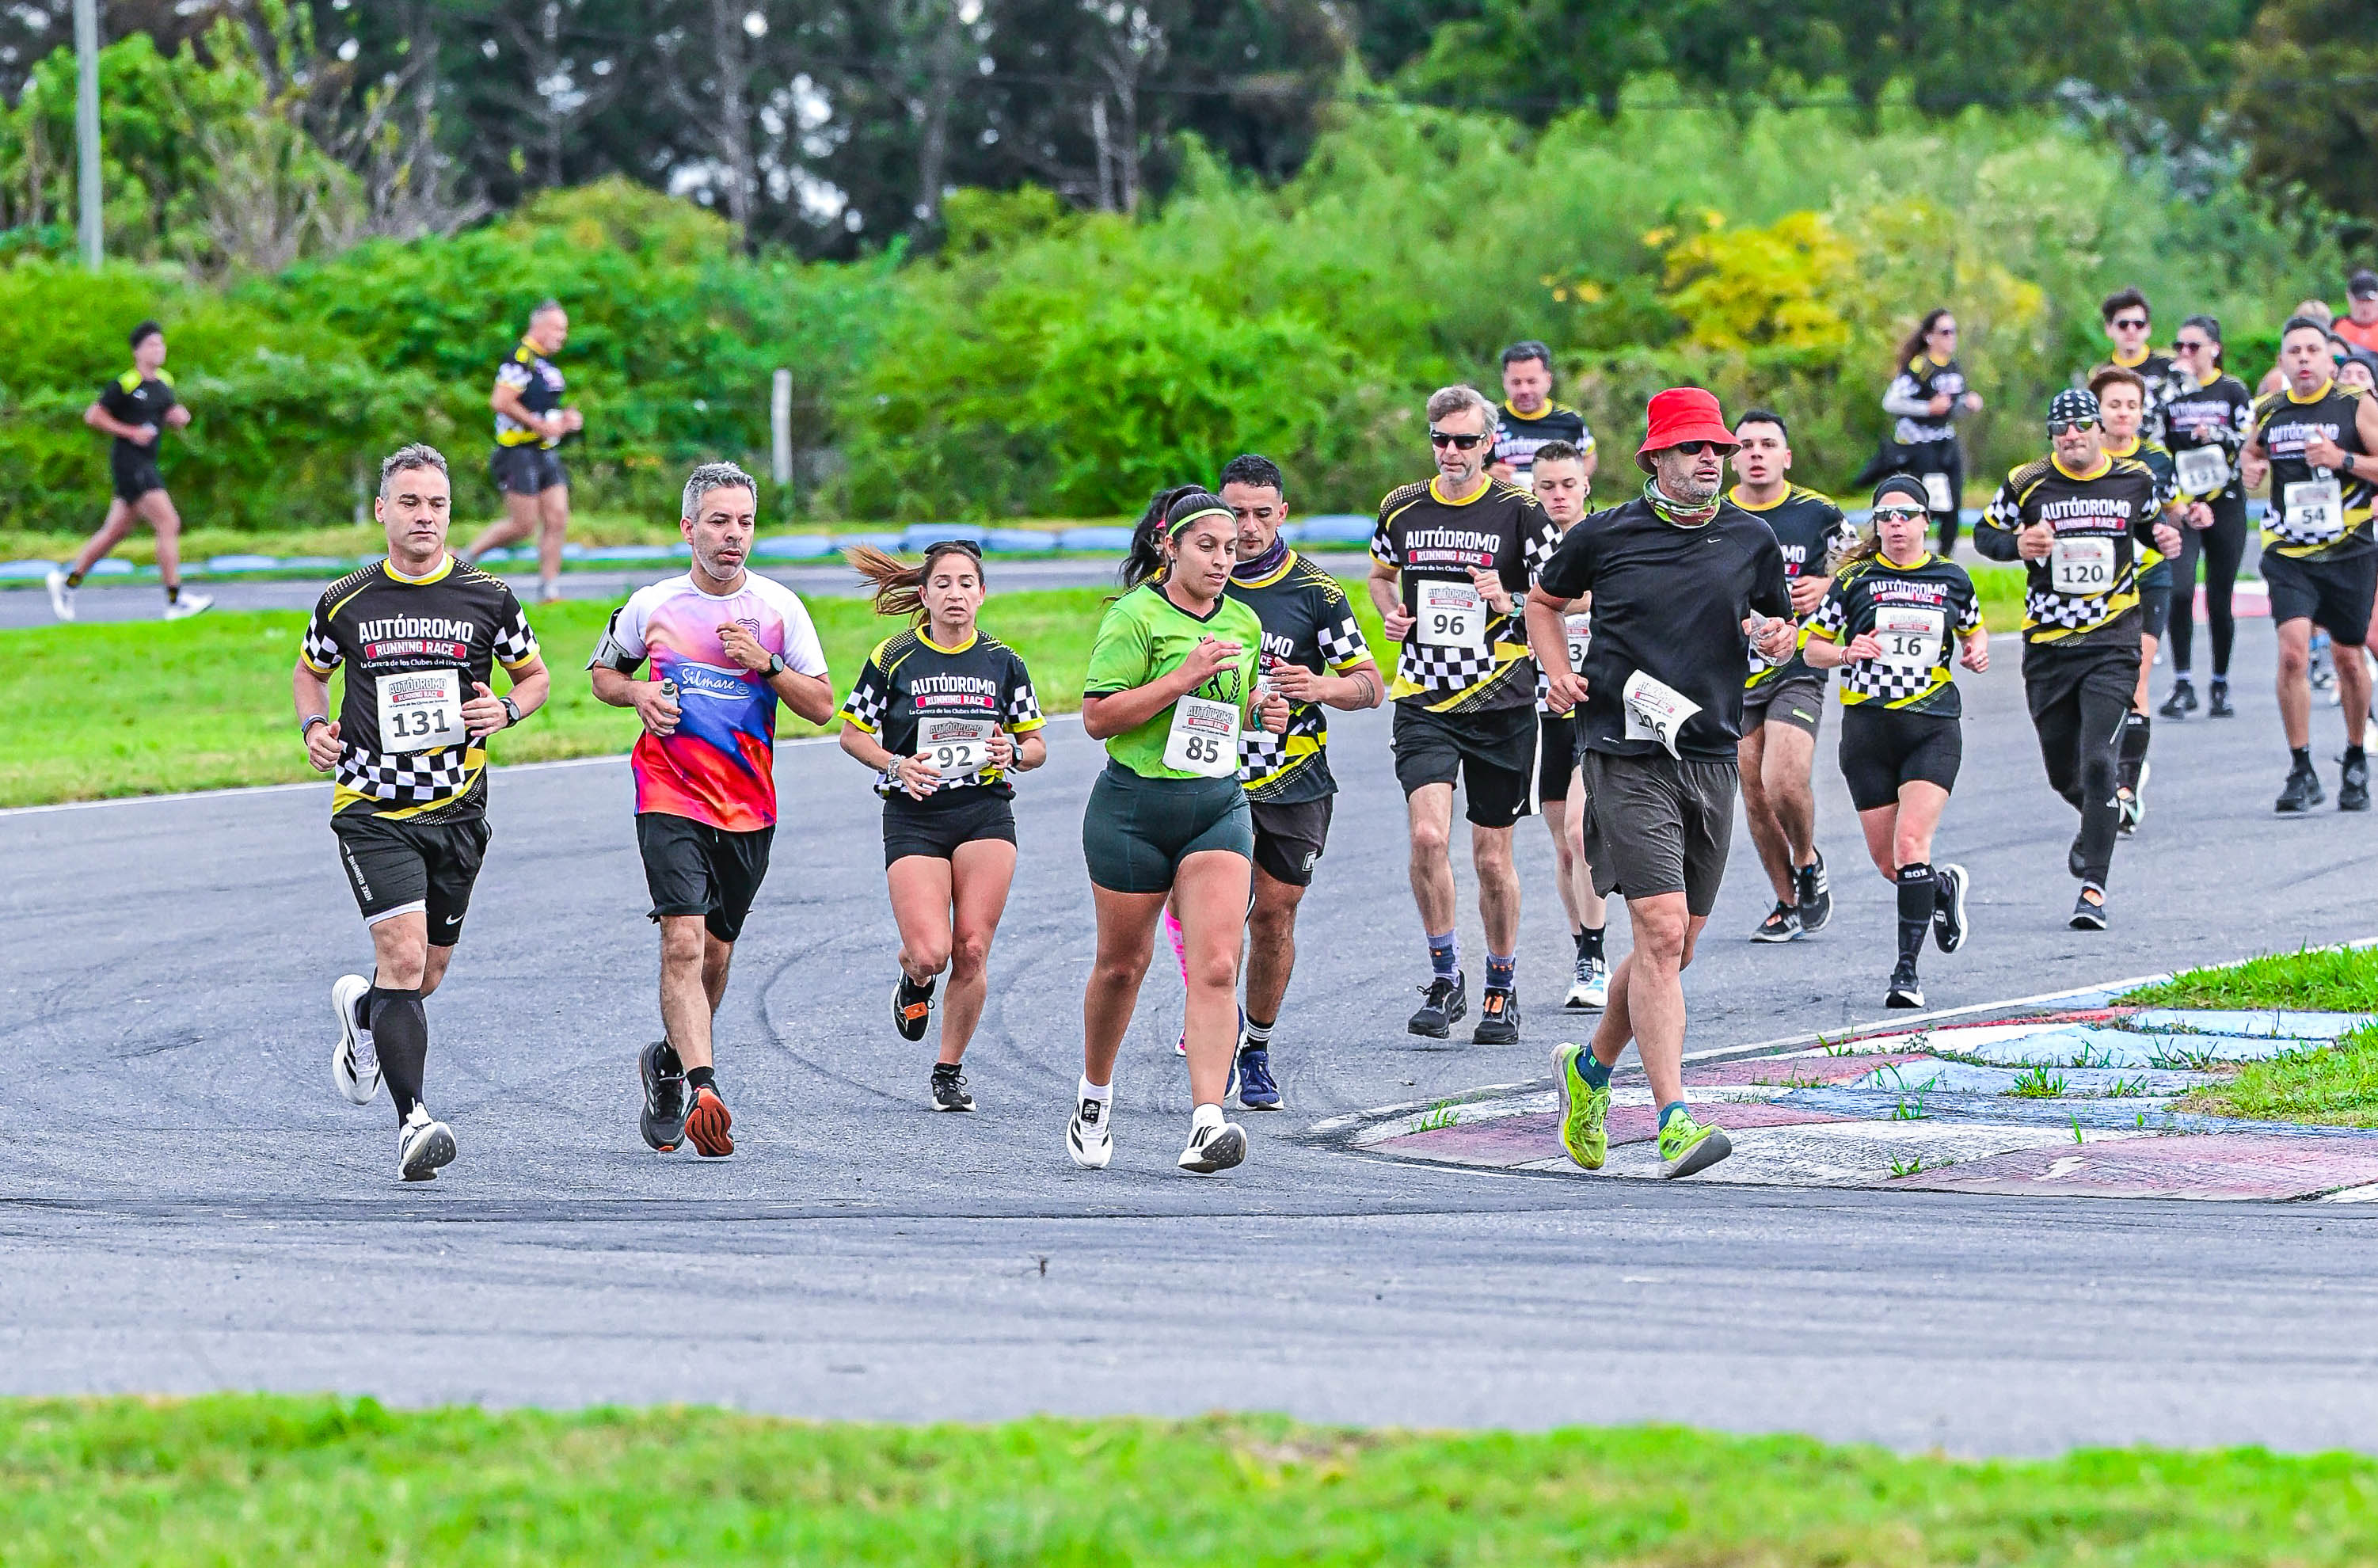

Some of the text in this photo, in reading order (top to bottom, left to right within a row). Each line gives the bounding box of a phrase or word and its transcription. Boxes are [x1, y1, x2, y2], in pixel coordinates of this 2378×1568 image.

[2041, 496, 2132, 519] AUTÓDROMO
[2303, 507, 2325, 523] 54
[1405, 526, 1501, 553] AUTÓDROMO
[1417, 550, 1482, 564] RUNNING RACE
[2062, 565, 2103, 583] 120
[1869, 579, 1948, 596] AUTÓDROMO
[359, 613, 474, 644] AUTÓDROMO
[1434, 615, 1464, 635] 96
[375, 641, 455, 656] RUNNING RACE
[1893, 637, 1921, 656] 16
[1260, 655, 1273, 667] CE
[389, 677, 447, 695] AUTÓDROMO
[682, 668, 735, 689] Silmare
[911, 672, 996, 696] AUTÓDROMO
[925, 695, 985, 706] RUNNING RACE
[392, 710, 450, 737] 131
[1187, 705, 1235, 724] AUTÓDROMO
[930, 721, 983, 734] AUTÓDROMO
[938, 746, 972, 768] 92
[1186, 736, 1218, 763] 85
[348, 855, 374, 901] NIKE RUNNING
